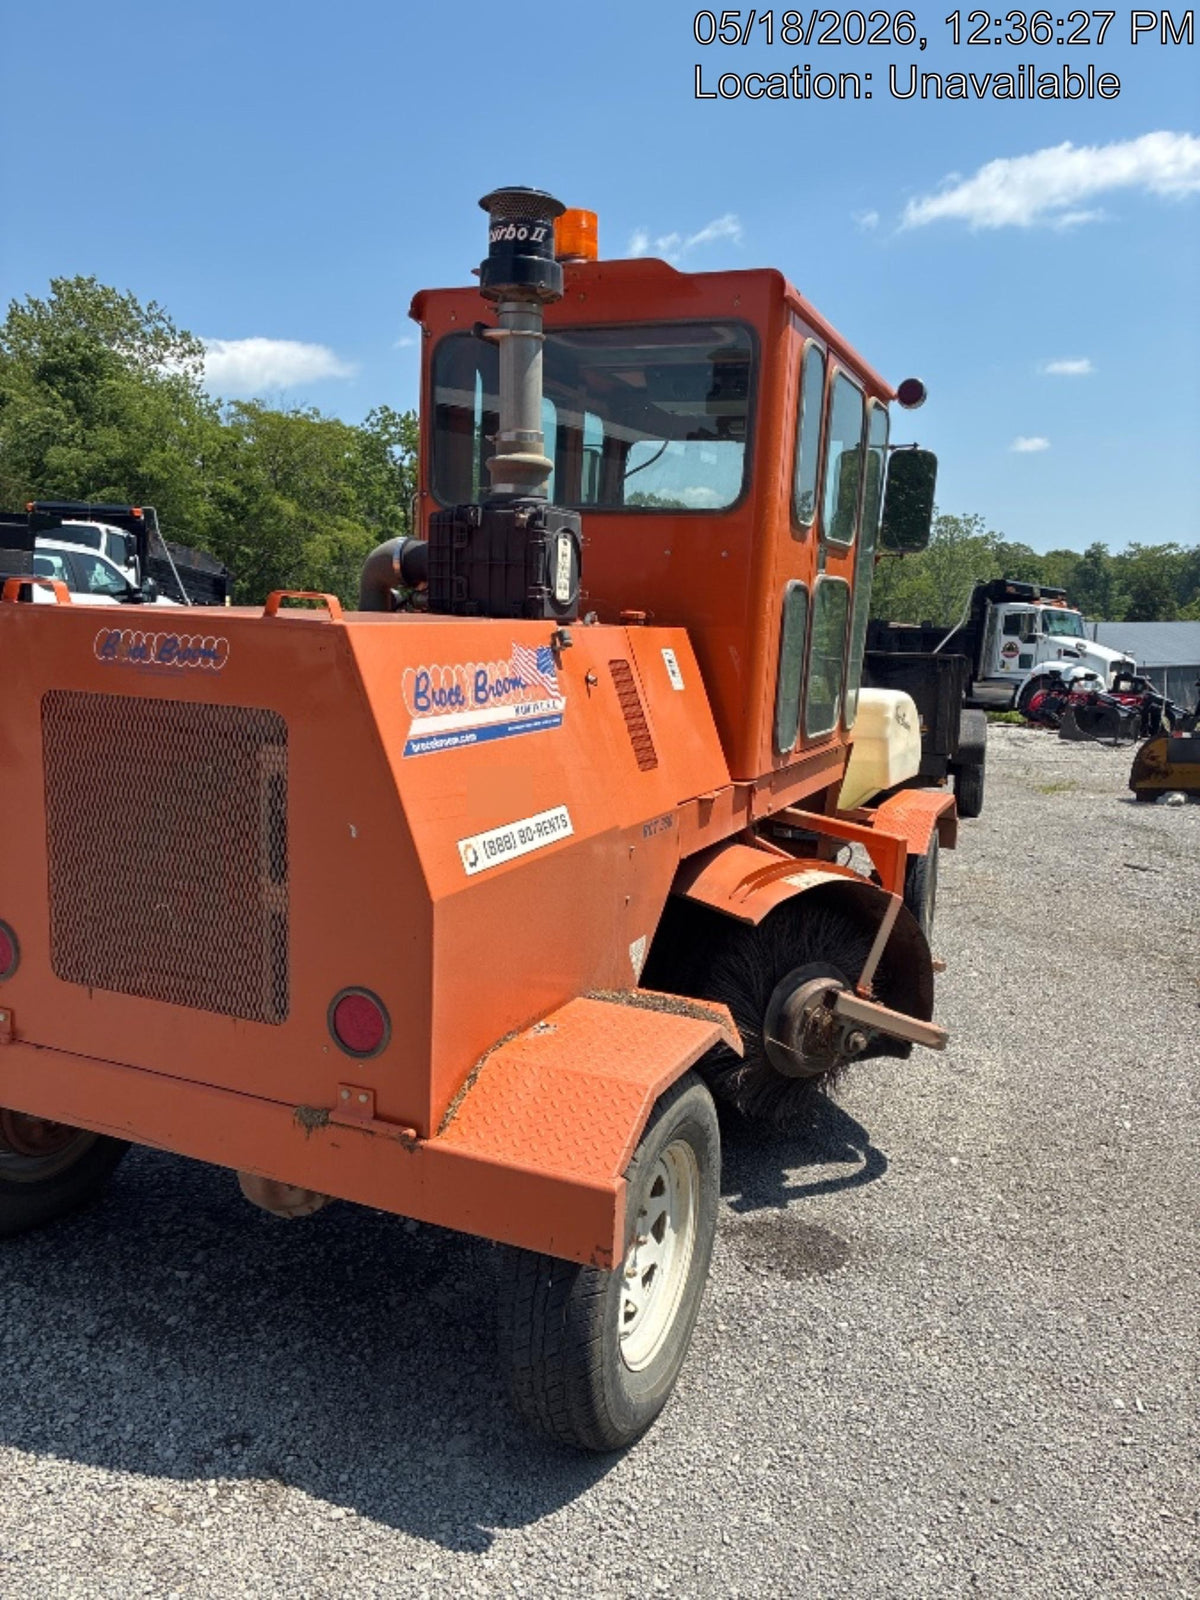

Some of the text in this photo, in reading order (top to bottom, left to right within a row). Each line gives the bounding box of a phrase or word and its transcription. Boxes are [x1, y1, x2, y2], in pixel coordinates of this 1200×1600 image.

[414, 669, 527, 711] Broce Broom
[483, 831, 517, 859] (888)
